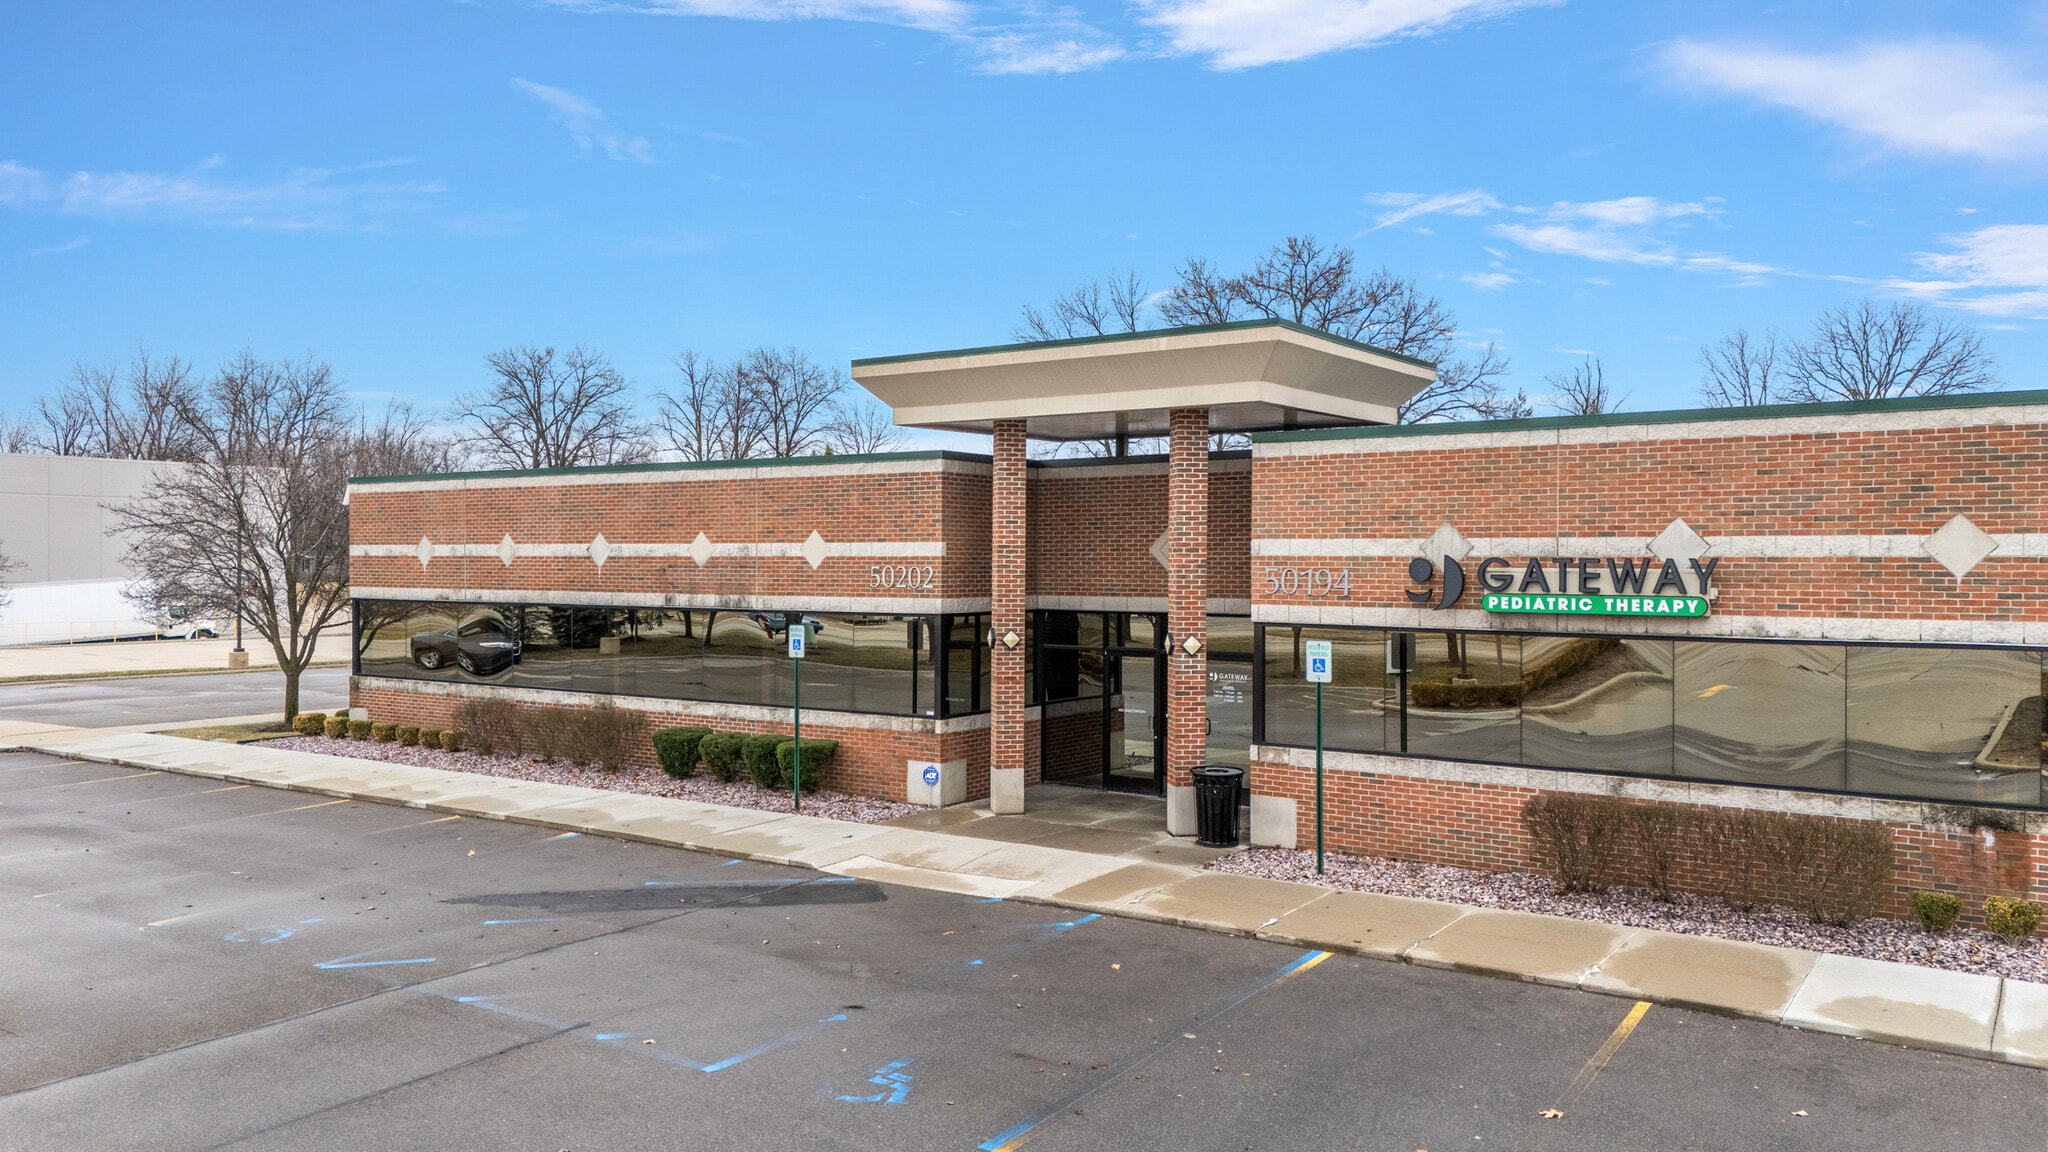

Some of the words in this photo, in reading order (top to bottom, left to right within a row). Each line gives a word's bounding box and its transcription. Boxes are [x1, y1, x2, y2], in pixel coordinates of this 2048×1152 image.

[869, 565, 934, 589] 50202
[1264, 566, 1353, 597] 50194
[1477, 557, 1719, 595] GATEWAY
[1488, 596, 1593, 611] PEDIATRIC
[1604, 598, 1699, 613] THERAPY
[1218, 672, 1248, 681] GATEWAY
